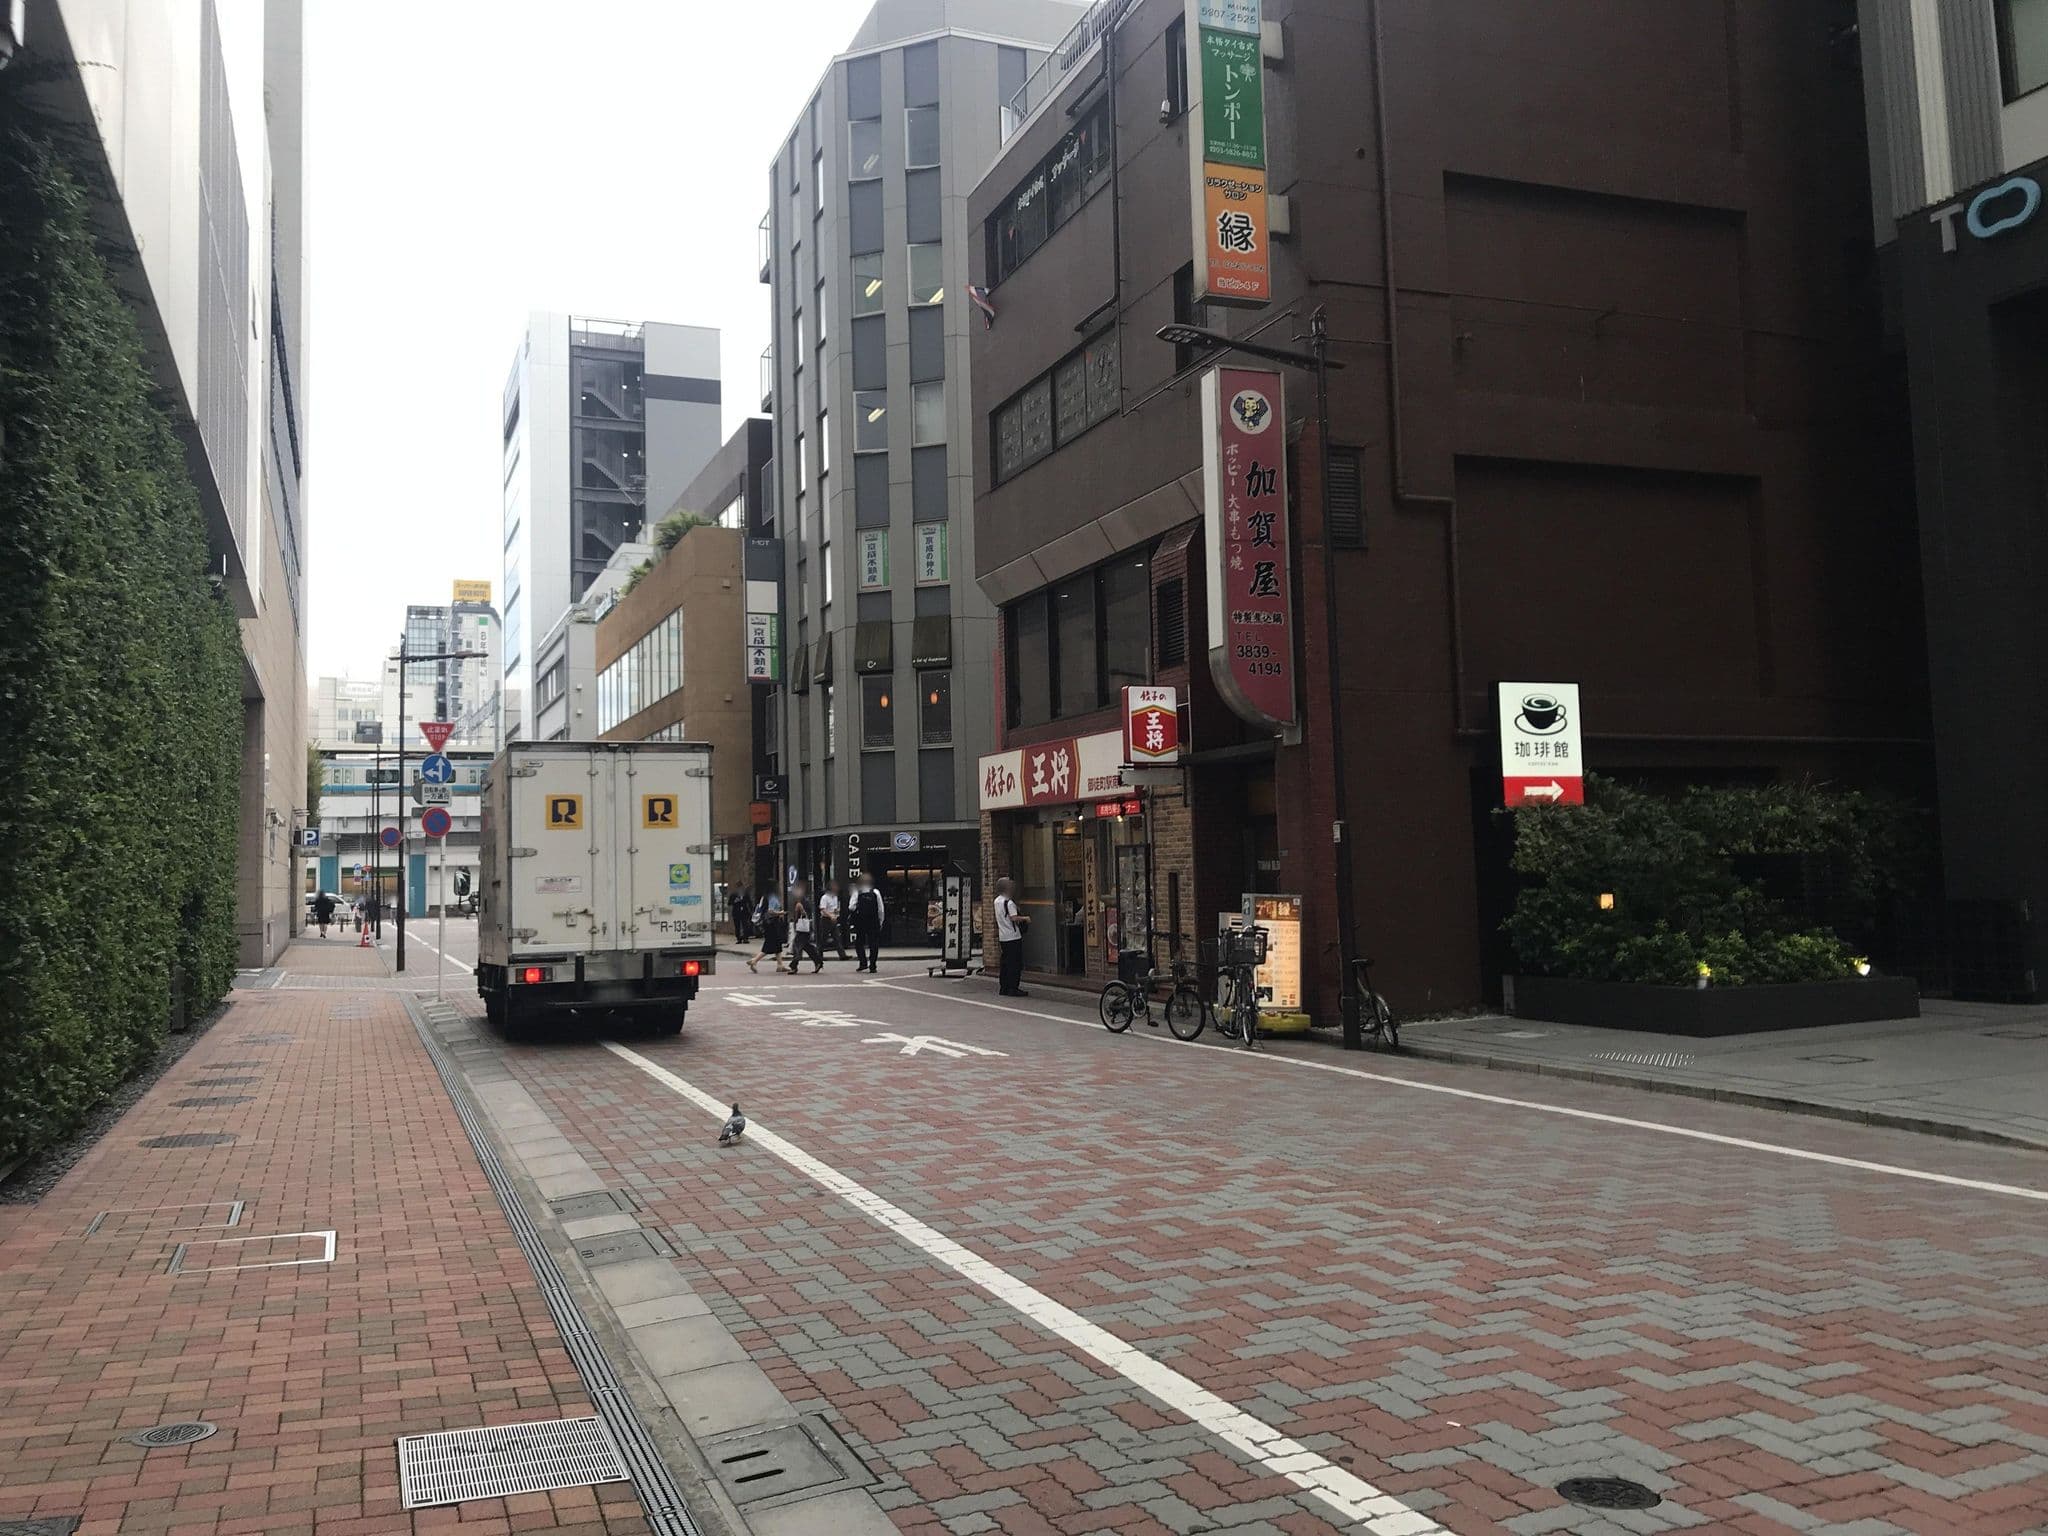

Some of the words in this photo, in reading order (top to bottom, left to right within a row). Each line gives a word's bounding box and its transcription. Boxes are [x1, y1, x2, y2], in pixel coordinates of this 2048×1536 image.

[1211, 48, 1251, 62] マッサージ
[1206, 176, 1263, 193] リラクゼーション
[1223, 189, 1247, 201] サロン
[1218, 212, 1255, 251] 縁
[1226, 443, 1241, 487] ホッピー
[1246, 461, 1281, 597] 加賀屋
[866, 543, 878, 583] 京成不動産
[1235, 631, 1262, 642] TEL
[752, 627, 766, 676] 京成不動産
[1237, 645, 1277, 659] 3839-
[1248, 662, 1282, 676] 4194
[1140, 690, 1167, 701] 餃子の
[1145, 711, 1165, 751] 王将
[1515, 741, 1569, 758] 珈琲館
[984, 764, 1016, 798] 餃子の
[1031, 747, 1071, 798] 王将
[303, 831, 317, 846] P
